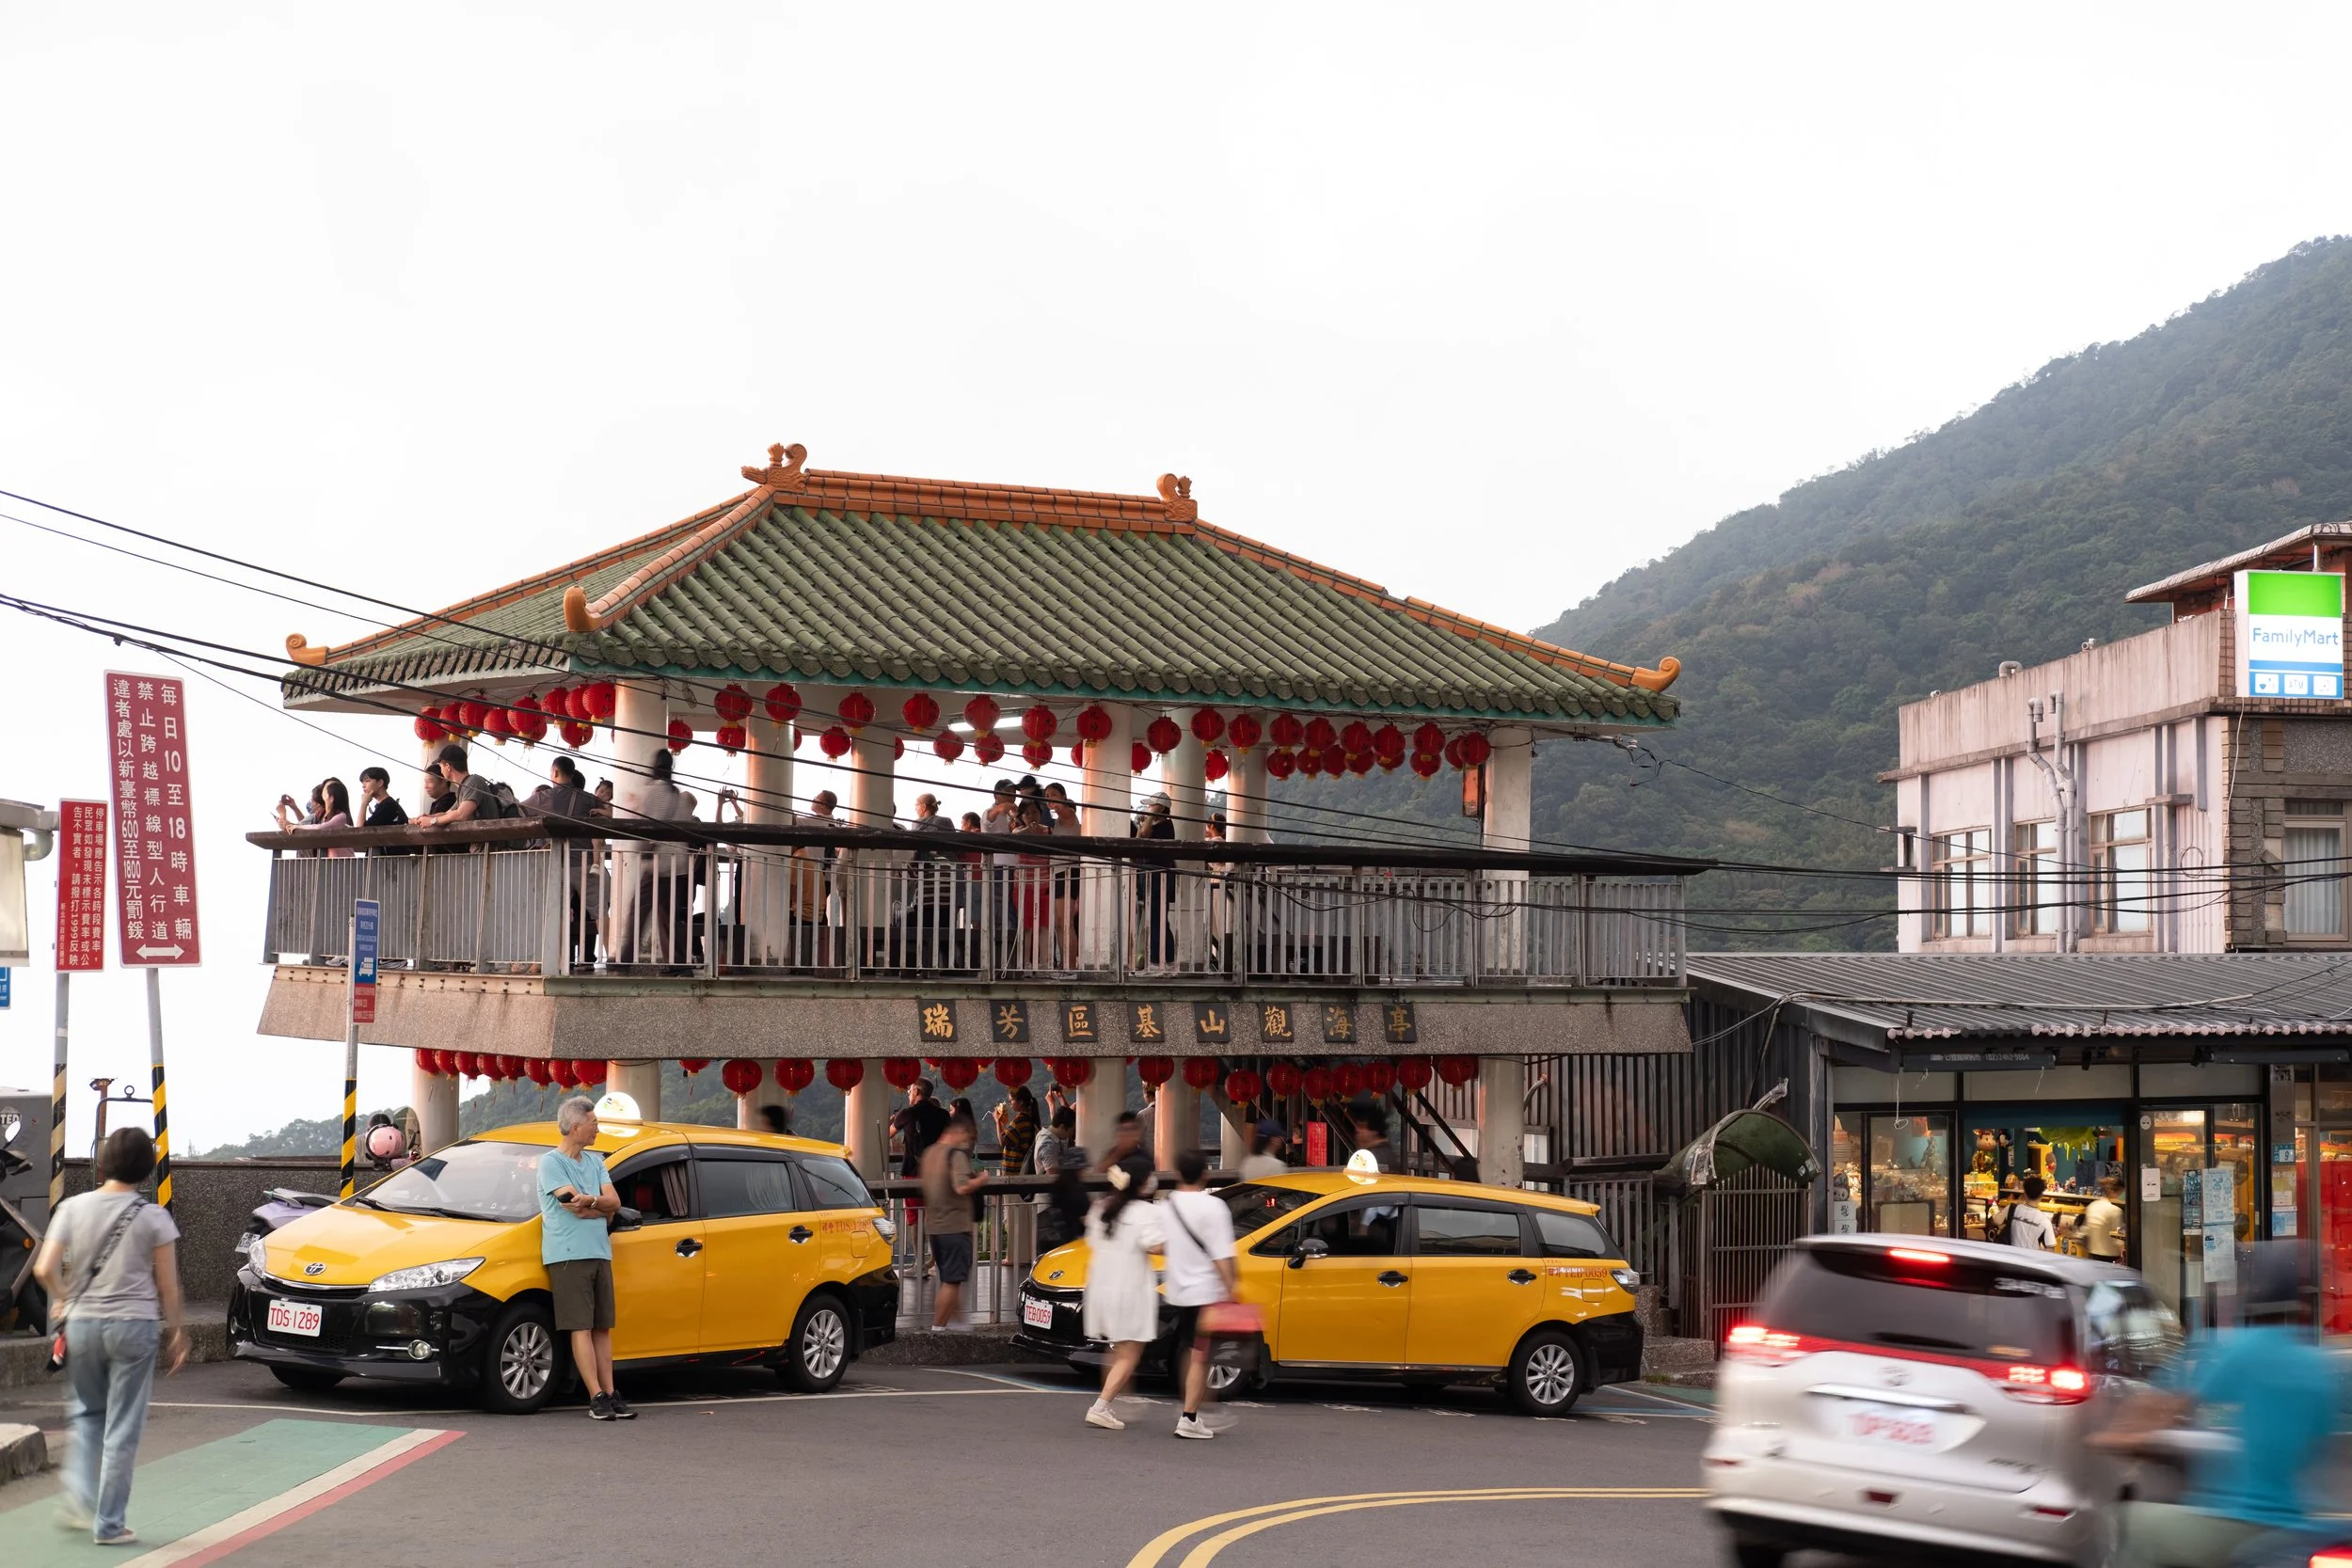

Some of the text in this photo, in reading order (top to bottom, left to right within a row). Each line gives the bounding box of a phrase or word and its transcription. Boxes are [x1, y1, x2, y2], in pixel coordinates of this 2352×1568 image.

[2252, 627, 2339, 647] FamilyMart
[113, 679, 144, 940] 違者處以新臺幣600至1800元罰鍰
[137, 680, 168, 940] 禁止跨越標線型人行道
[161, 683, 192, 940] 每日10至18時車輛
[923, 1004, 1411, 1038] 瑞芳區基山觀海亭
